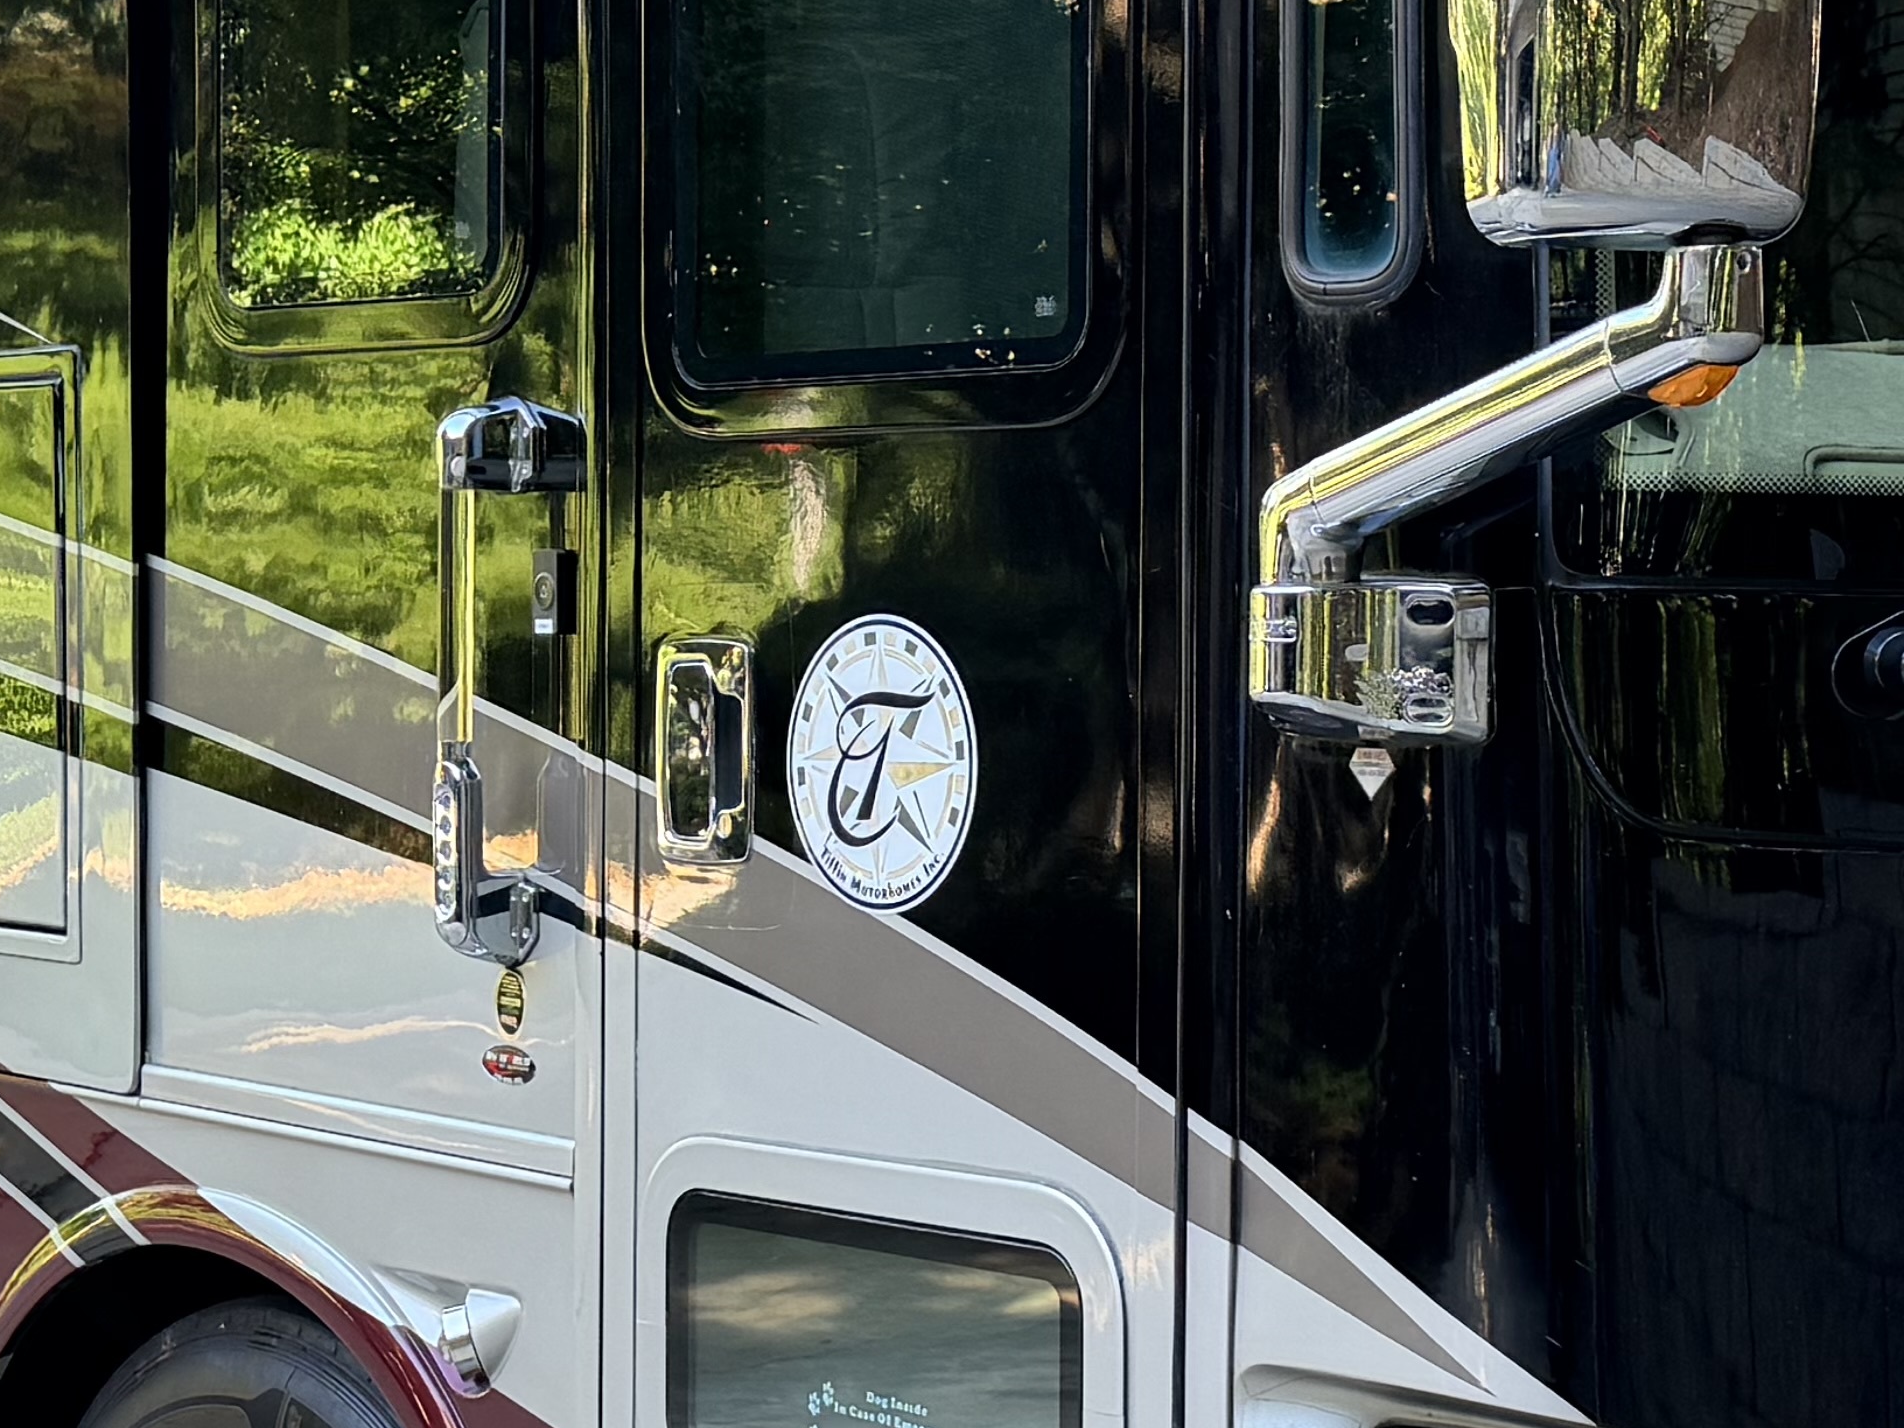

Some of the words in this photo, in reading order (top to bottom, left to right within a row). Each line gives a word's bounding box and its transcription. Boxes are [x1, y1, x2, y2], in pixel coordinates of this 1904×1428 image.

[834, 1401, 847, 1415] In
[848, 1405, 876, 1422] Case
[865, 1391, 889, 1409] Dog
[890, 1396, 928, 1417] Inside
